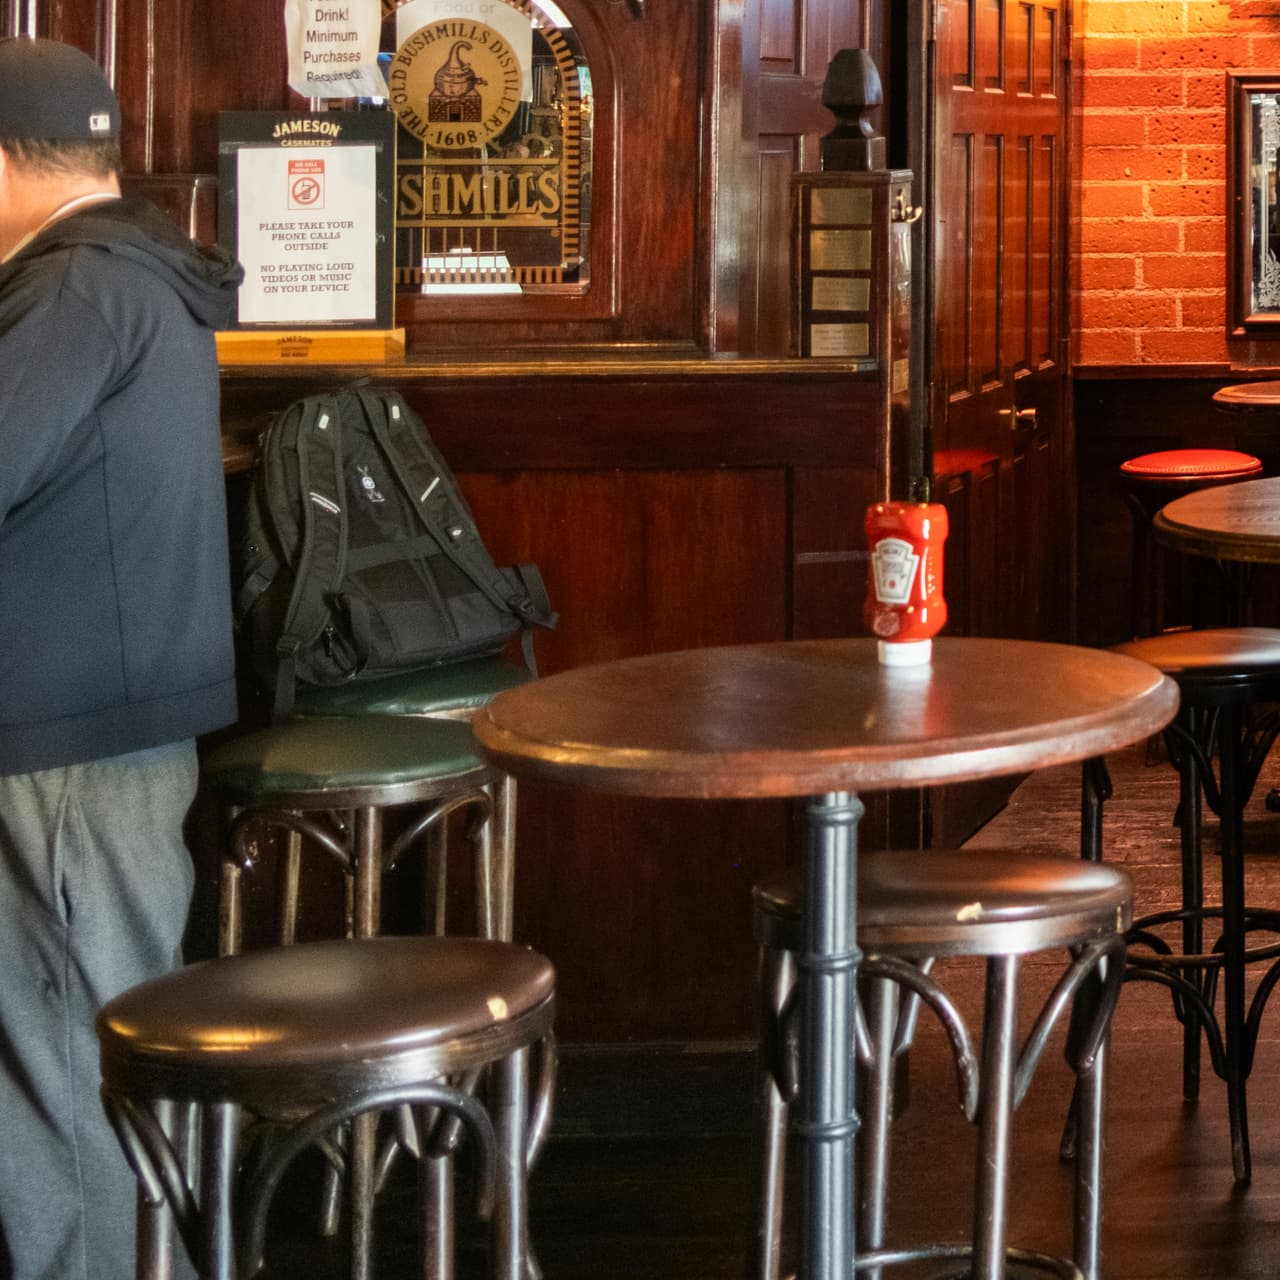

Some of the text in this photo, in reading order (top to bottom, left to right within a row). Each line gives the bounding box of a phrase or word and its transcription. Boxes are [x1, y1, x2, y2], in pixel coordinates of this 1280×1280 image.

[315, 7, 350, 23] Drink!
[306, 30, 358, 43] Minimum
[303, 50, 361, 64] Purchases
[306, 70, 364, 84] Required!
[391, 22, 519, 139] THE OLD BUSHMILLS DISTILLERY
[272, 119, 340, 138] JAMESON
[435, 129, 478, 146] 1608
[400, 170, 561, 216] SHMILLS
[259, 221, 355, 231] PLEASE TAKE YOUR
[271, 231, 342, 241] PHONE CALLS
[284, 242, 329, 251] OUTSIDE
[260, 262, 355, 272] NO PLAYING LOUD
[260, 273, 353, 283] VIDEOS OR MUSIC
[263, 283, 350, 294] ON YOUR DEVICE
